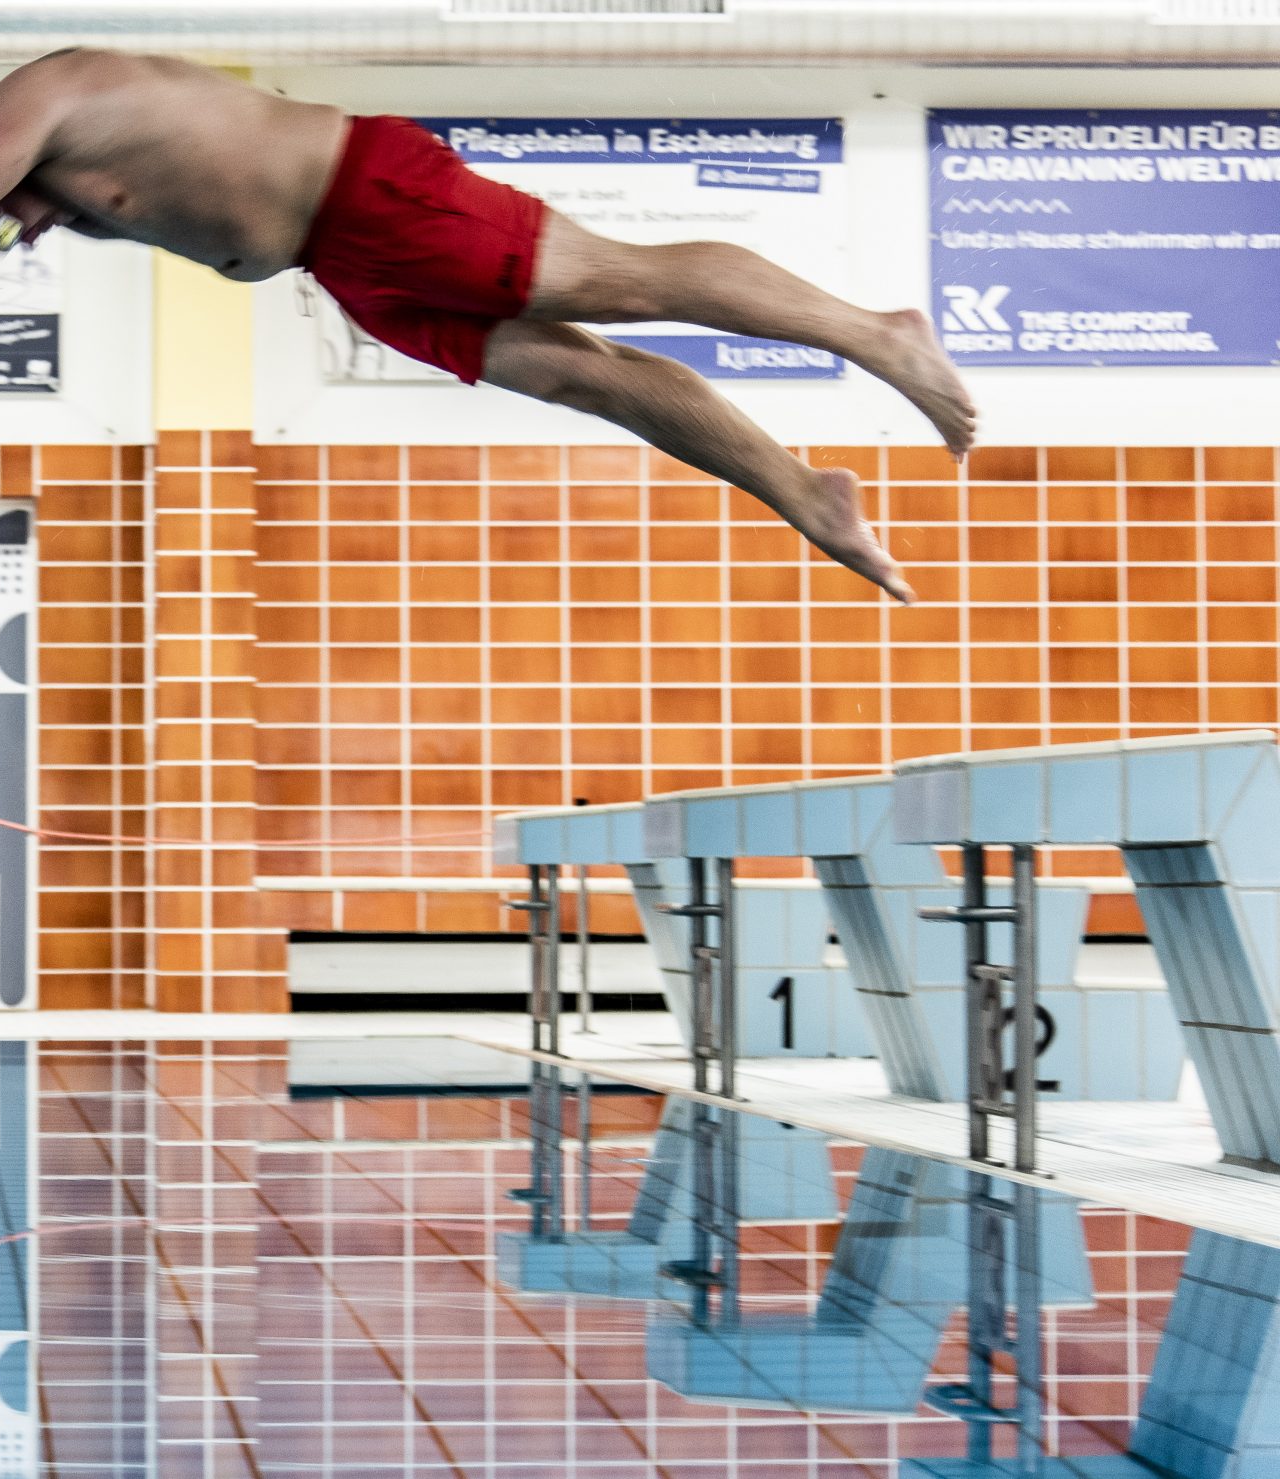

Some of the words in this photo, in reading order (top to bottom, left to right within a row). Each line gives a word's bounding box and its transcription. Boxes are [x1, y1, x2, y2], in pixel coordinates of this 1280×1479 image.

[448, 126, 609, 158] Pflegeheim
[613, 128, 644, 153] in
[648, 127, 818, 159] Eschenburg
[941, 124, 1009, 150] WIR
[1011, 124, 1186, 150] SPRUDELN
[1187, 120, 1257, 150] FÜR
[941, 155, 1156, 182] CARAVANING
[768, 976, 794, 1050] 1
